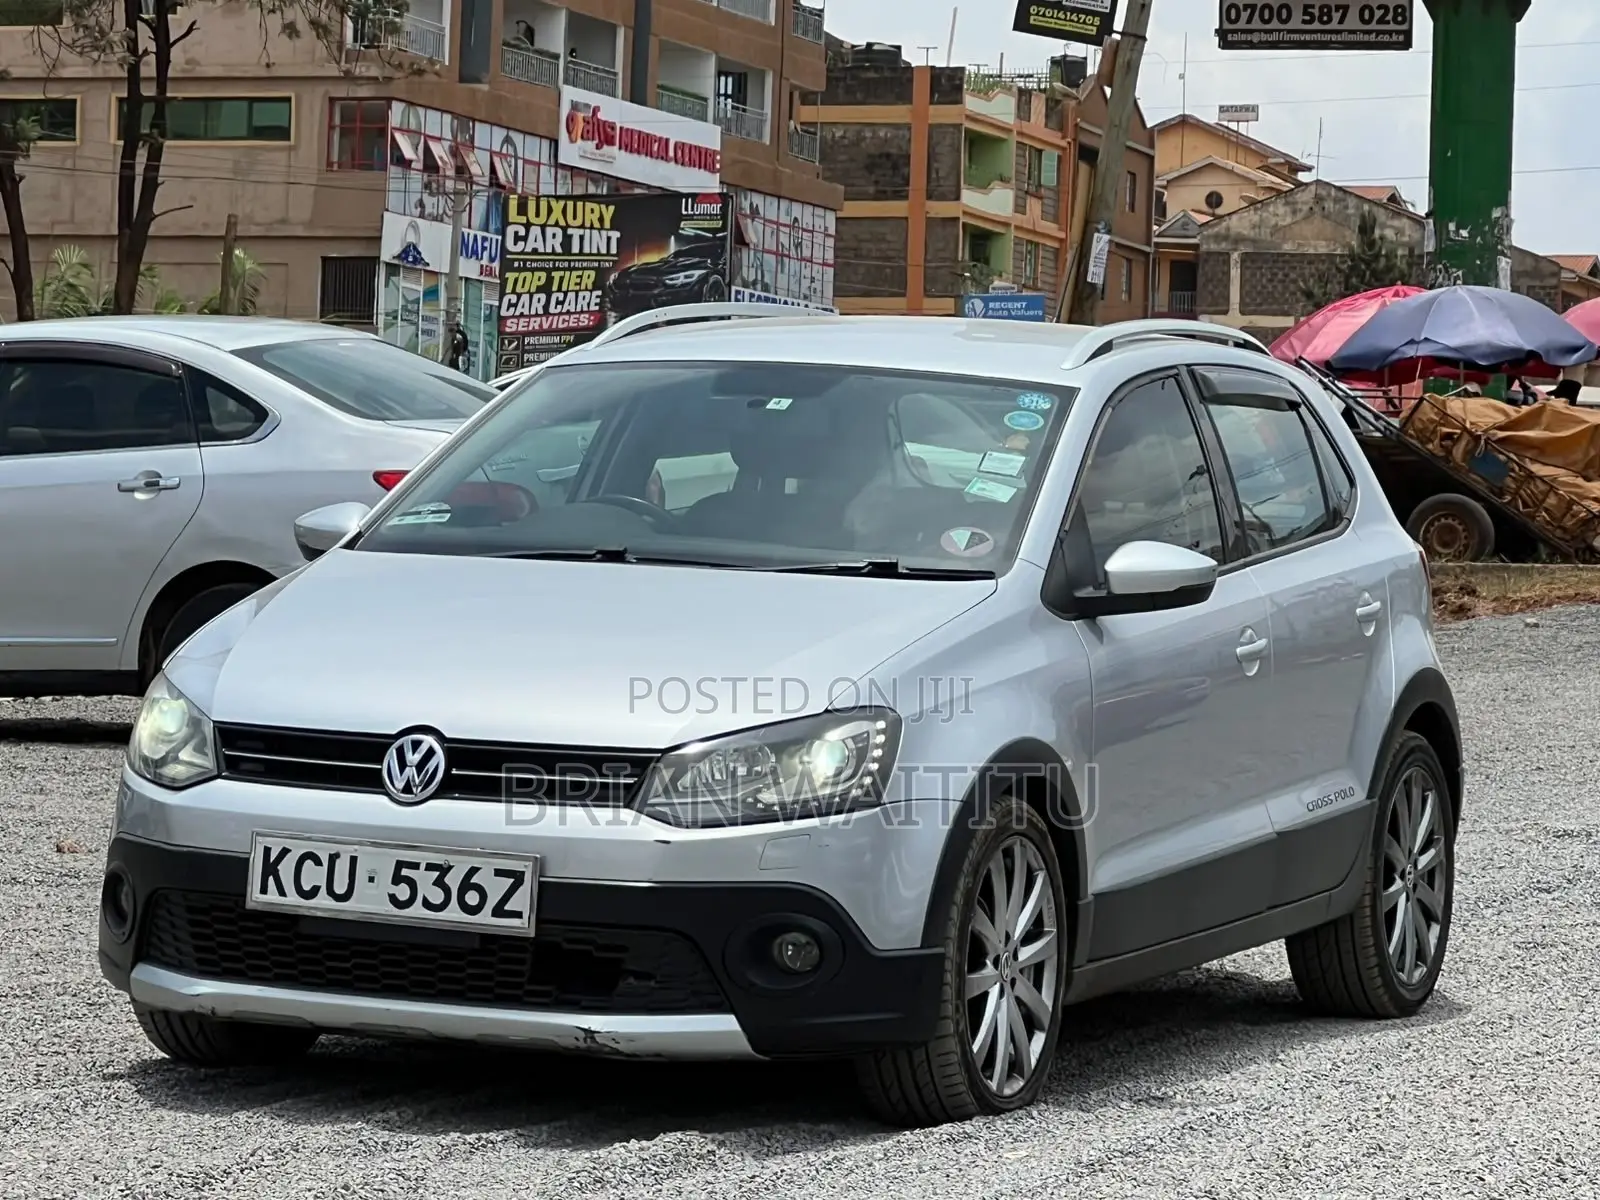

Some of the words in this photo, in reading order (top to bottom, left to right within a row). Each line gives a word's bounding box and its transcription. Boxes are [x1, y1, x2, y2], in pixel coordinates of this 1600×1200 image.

[1030, 5, 1100, 26] 0701414705
[1225, 3, 1292, 25] 0700
[1301, 3, 1350, 25] 587
[1358, 3, 1408, 25] 028
[618, 126, 673, 162] MEDICAL
[674, 141, 721, 173] CENTRE
[508, 194, 616, 229] LUXURY
[681, 197, 722, 214] LLumar
[460, 231, 500, 264] NAFU
[505, 224, 563, 253] CAR
[567, 227, 621, 254] TINT
[504, 271, 547, 293] TOP
[551, 270, 596, 291] TIER
[500, 293, 547, 316] CAR
[548, 290, 602, 314] CARE
[988, 301, 1028, 309] REGENT
[504, 313, 595, 332] SERVICES:
[524, 335, 560, 345] PREMIUM
[1306, 793, 1334, 812] CROSS
[1333, 786, 1355, 802] POLO
[259, 845, 359, 903] KCU
[387, 859, 526, 920] 536Z
